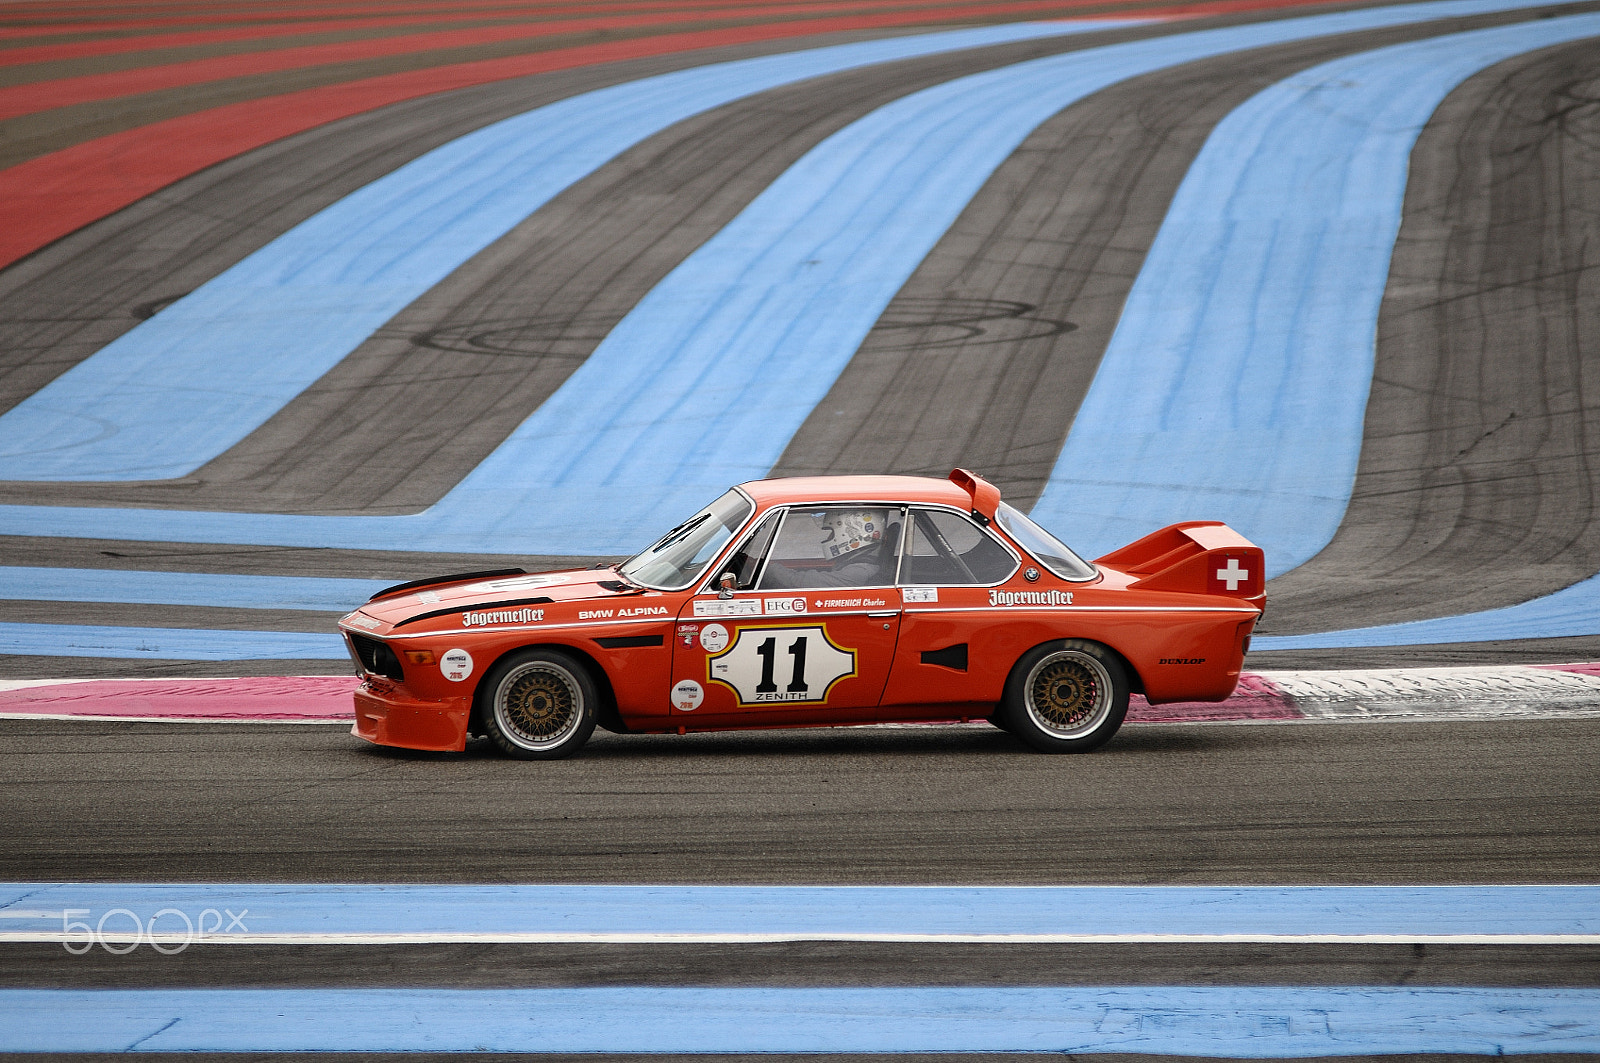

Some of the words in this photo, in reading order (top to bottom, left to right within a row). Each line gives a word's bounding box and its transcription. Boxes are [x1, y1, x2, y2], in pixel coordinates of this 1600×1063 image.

[767, 601, 791, 611] EFG
[824, 599, 861, 608] FIRMENICH
[863, 599, 886, 607] Charles
[578, 611, 613, 620] BMW
[617, 606, 669, 617] ALPINA
[755, 636, 809, 693] 11
[756, 692, 808, 701] ZENITH
